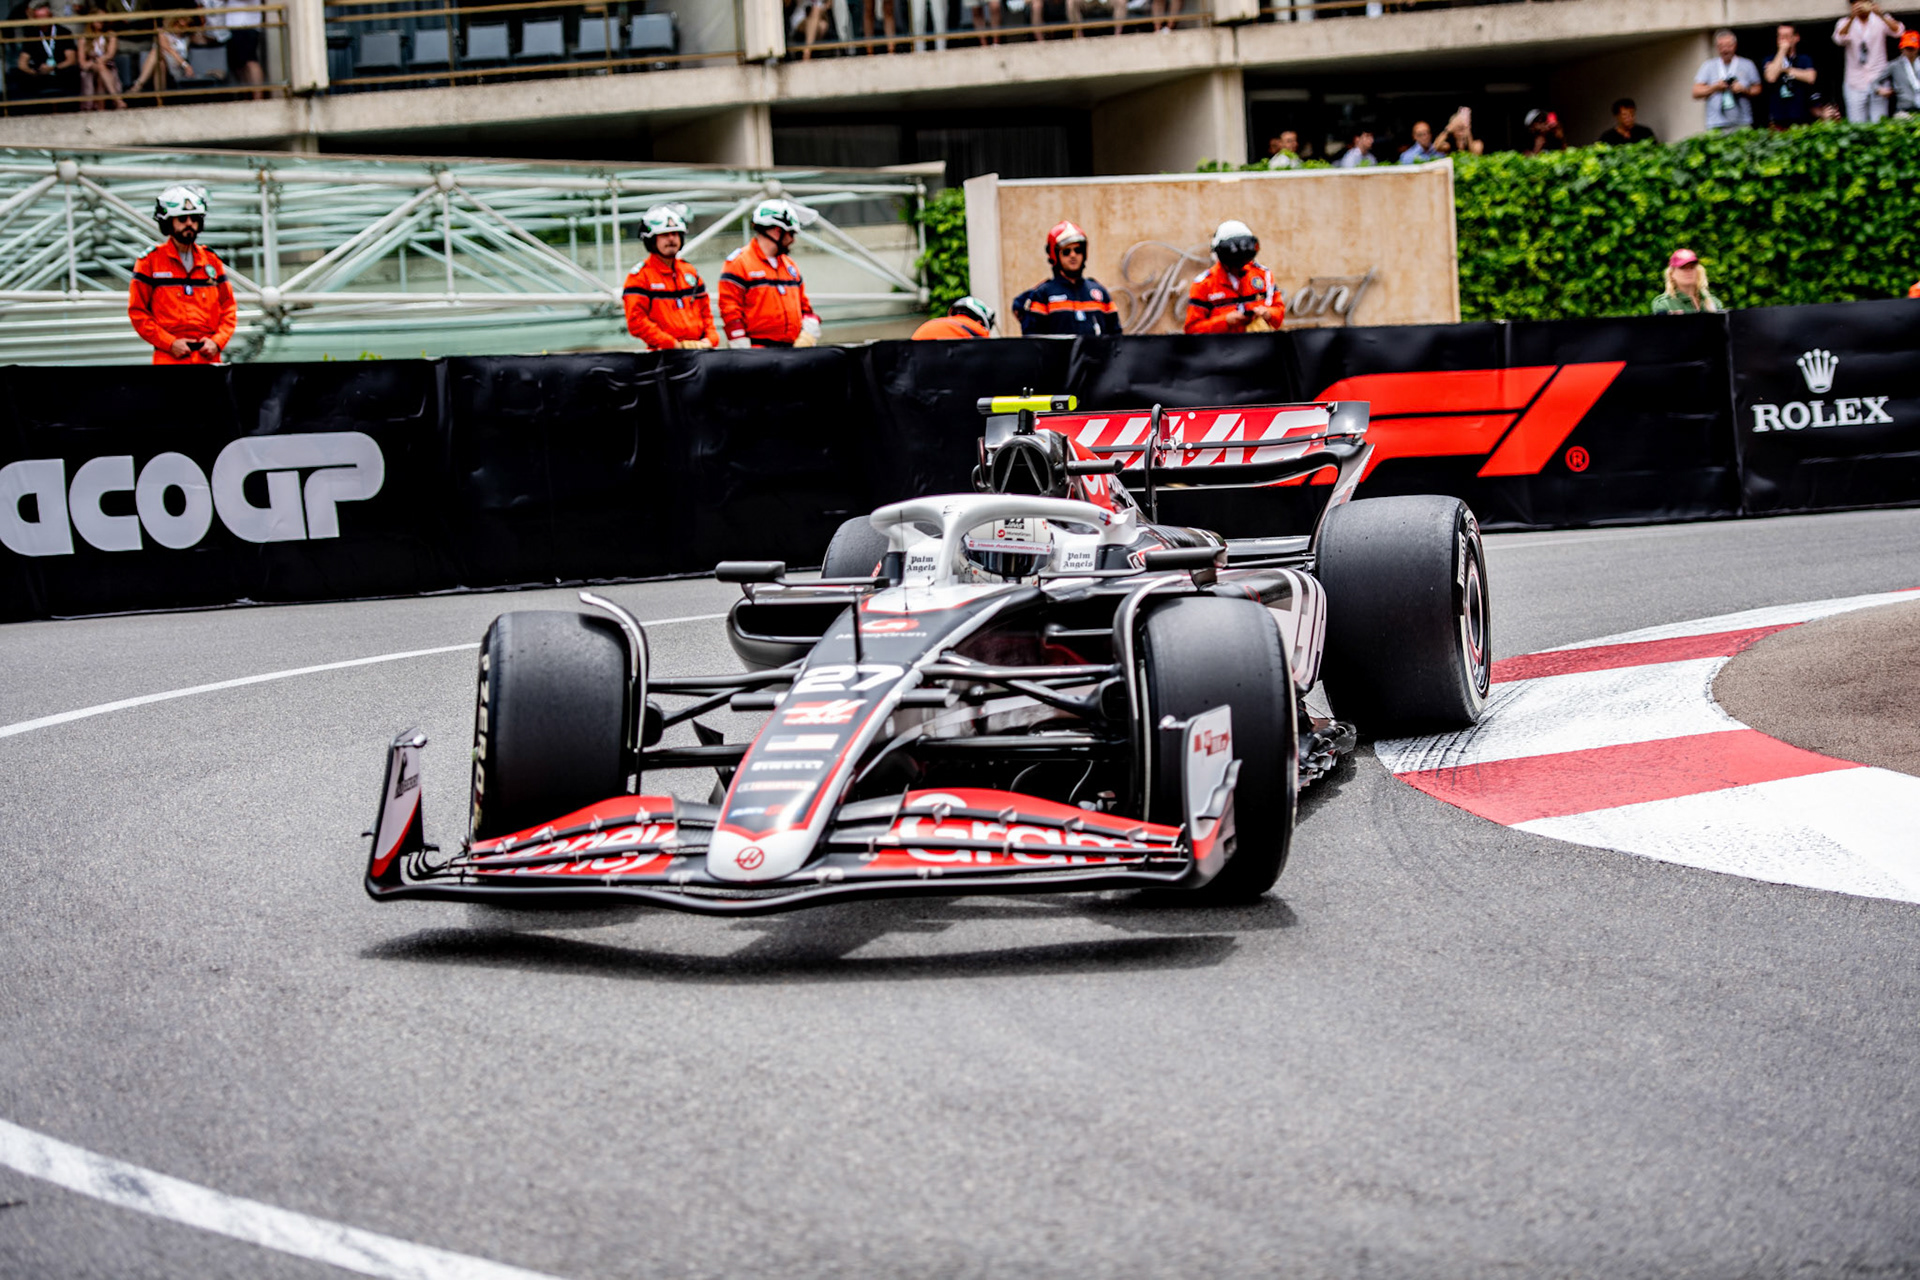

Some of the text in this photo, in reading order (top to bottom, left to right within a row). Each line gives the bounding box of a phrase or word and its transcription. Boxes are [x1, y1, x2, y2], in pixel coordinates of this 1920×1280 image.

[1751, 396, 1894, 432] ROLEX
[1067, 552, 1091, 560] Palm
[906, 564, 937, 573] Angels
[1063, 561, 1093, 569] Angels
[791, 664, 905, 694] 27
